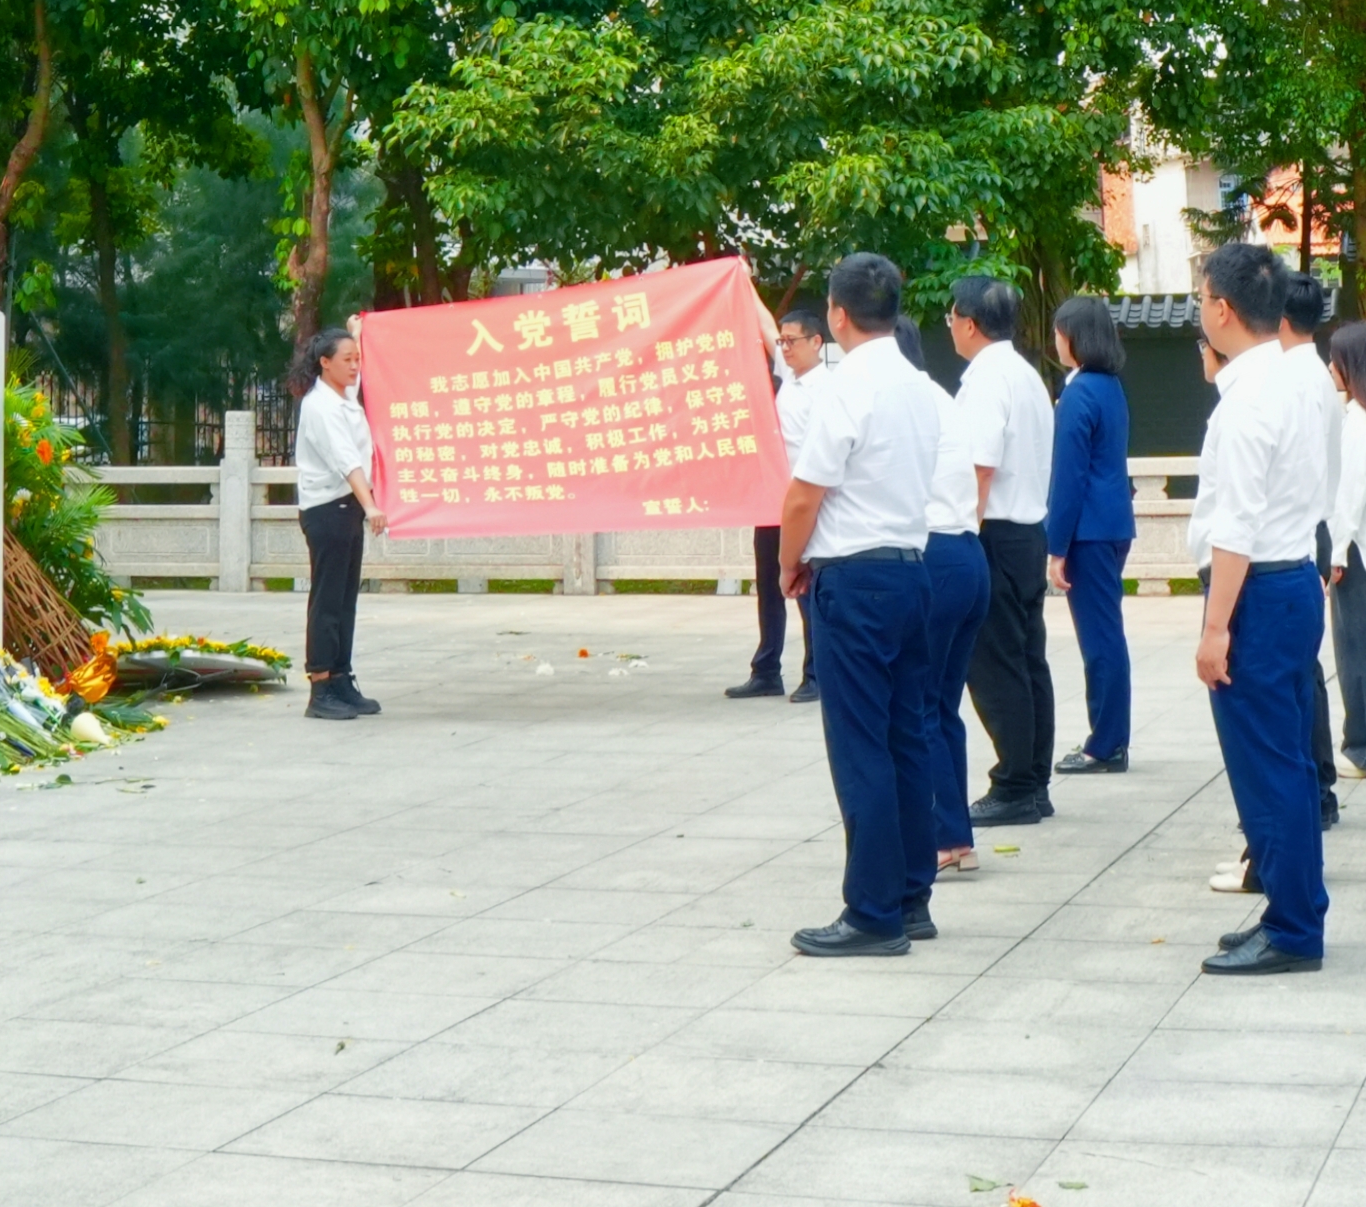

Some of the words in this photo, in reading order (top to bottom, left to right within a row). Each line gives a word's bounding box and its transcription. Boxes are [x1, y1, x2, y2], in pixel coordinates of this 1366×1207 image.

[466, 292, 652, 356] 入党誓词
[390, 357, 732, 420] 纲领，遵守党的章程，履行党员义务，
[430, 330, 735, 394] 我志愿加入中国共产党，拥护党的
[392, 382, 747, 441] 执行党的决定，严守党的纪律，保守党
[395, 409, 752, 464] 的秘密，对党忠诚，积极工作，为共产
[398, 435, 758, 484] 主义奋斗终身，随时准备为党和人民牺
[400, 485, 578, 504] 牲一切，永不叛党。
